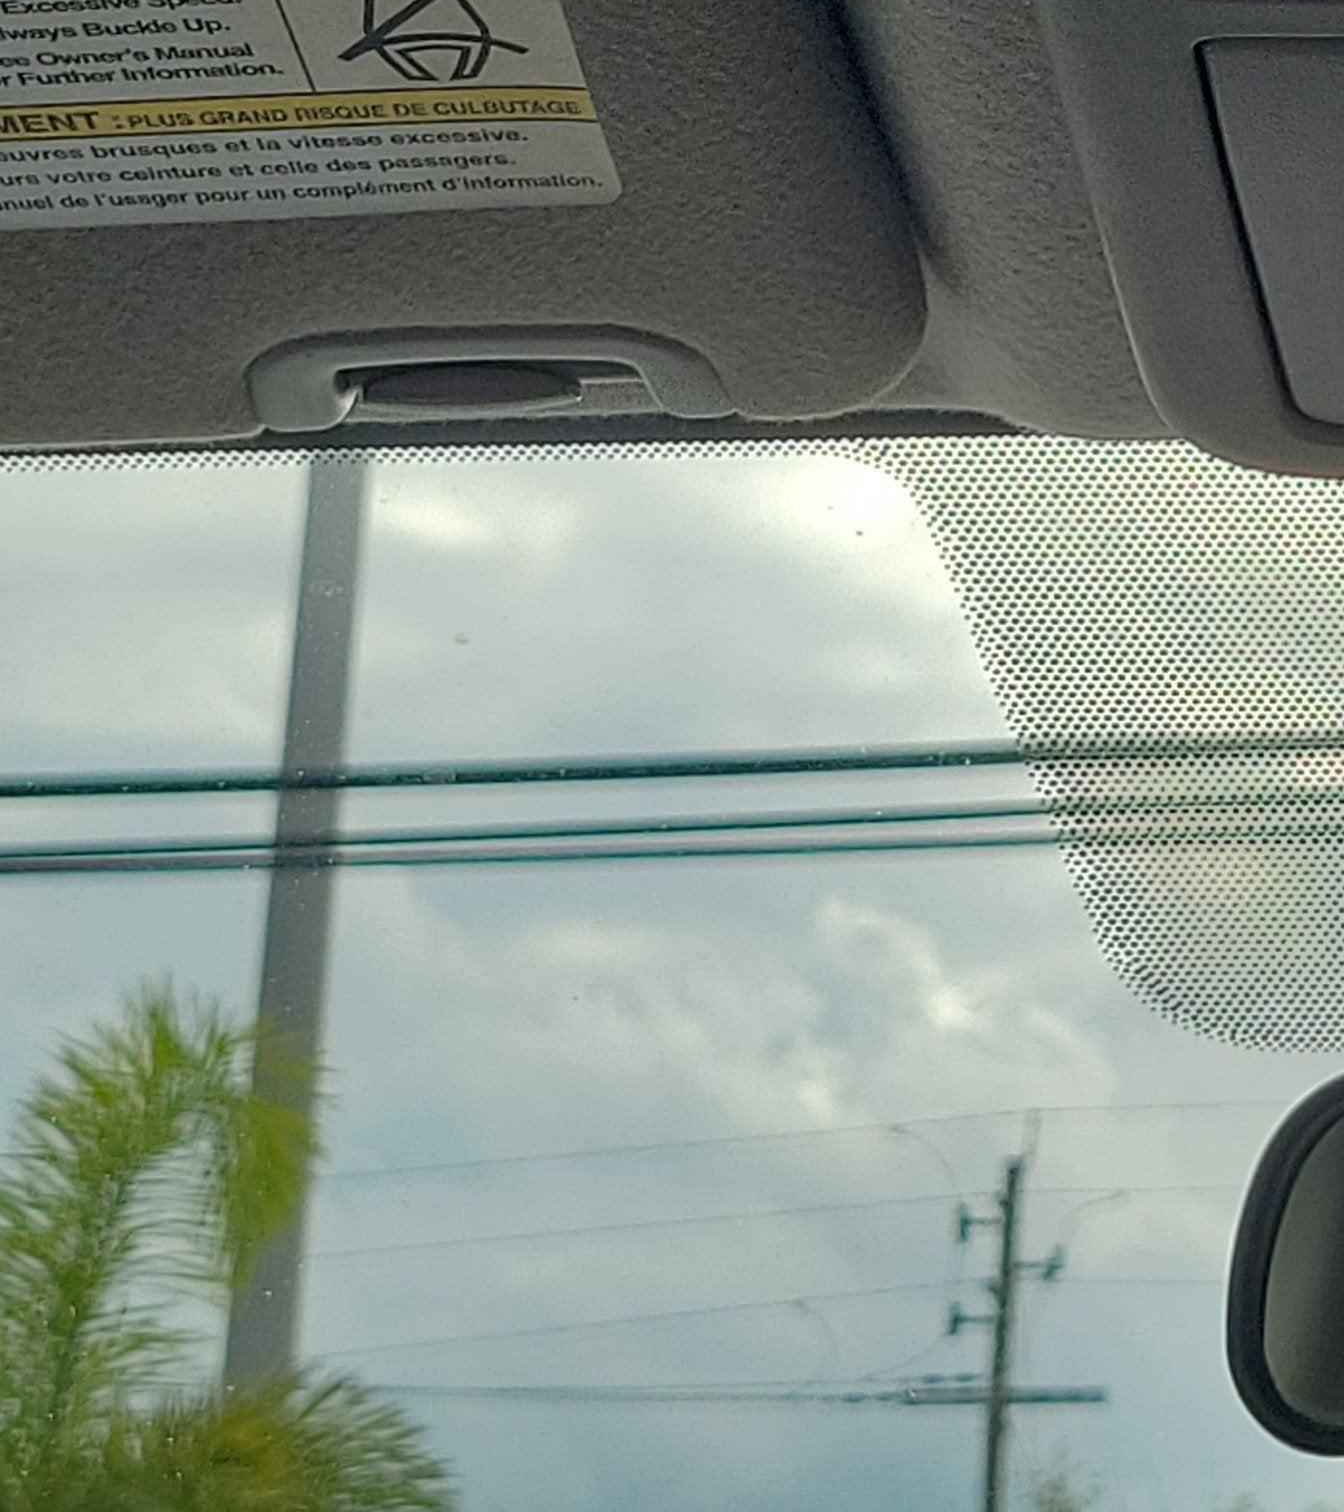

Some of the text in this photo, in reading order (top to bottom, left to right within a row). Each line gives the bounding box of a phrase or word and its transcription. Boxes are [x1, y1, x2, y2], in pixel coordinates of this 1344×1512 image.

[83, 18, 177, 37] Buckle
[182, 18, 230, 35] Up.
[36, 47, 149, 66] Owner's
[154, 42, 254, 61] Manual
[18, 66, 114, 86] Further
[121, 61, 284, 82] Information.
[0, 111, 98, 133] MENT
[129, 112, 194, 128] PLUS
[200, 107, 287, 126] GRAND
[295, 102, 386, 121] RISQUE
[392, 101, 425, 117] DE
[433, 99, 582, 116] CULBUTAGE
[91, 141, 217, 160] brusques
[225, 139, 250, 152] et
[257, 137, 280, 151] la
[288, 133, 383, 151] vitesse
[390, 126, 529, 145] excessive.
[46, 169, 111, 185] votre
[119, 164, 222, 182] ceinture
[229, 162, 254, 177] et
[260, 159, 318, 176] celle
[326, 157, 372, 172] des
[380, 152, 516, 173] passagers.
[0, 172, 604, 211] nuel de l'usager pour un complément d'information.
